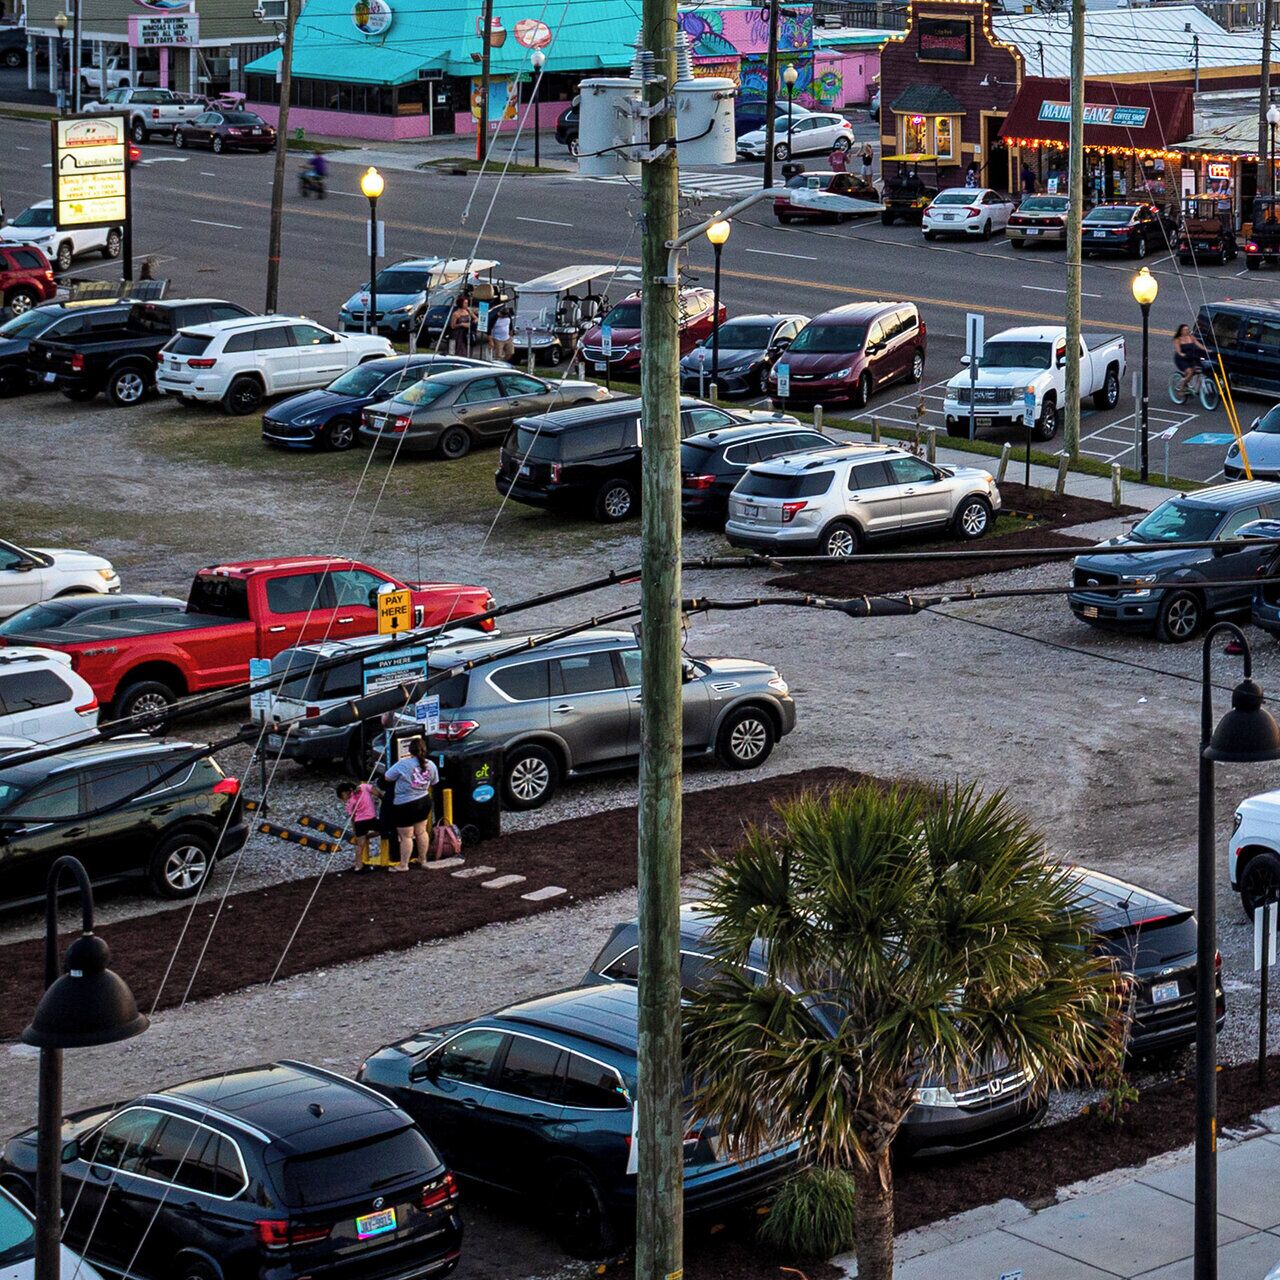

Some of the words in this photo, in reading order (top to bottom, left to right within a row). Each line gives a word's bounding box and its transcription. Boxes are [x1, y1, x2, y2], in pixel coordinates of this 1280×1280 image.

[1082, 106, 1112, 122] EANZ
[1114, 111, 1131, 120] COFFEE
[1131, 113, 1145, 122] SHOP
[385, 594, 403, 605] PAY
[381, 605, 407, 617] HERE
[379, 659, 393, 668] PAY
[393, 657, 411, 666] HERE
